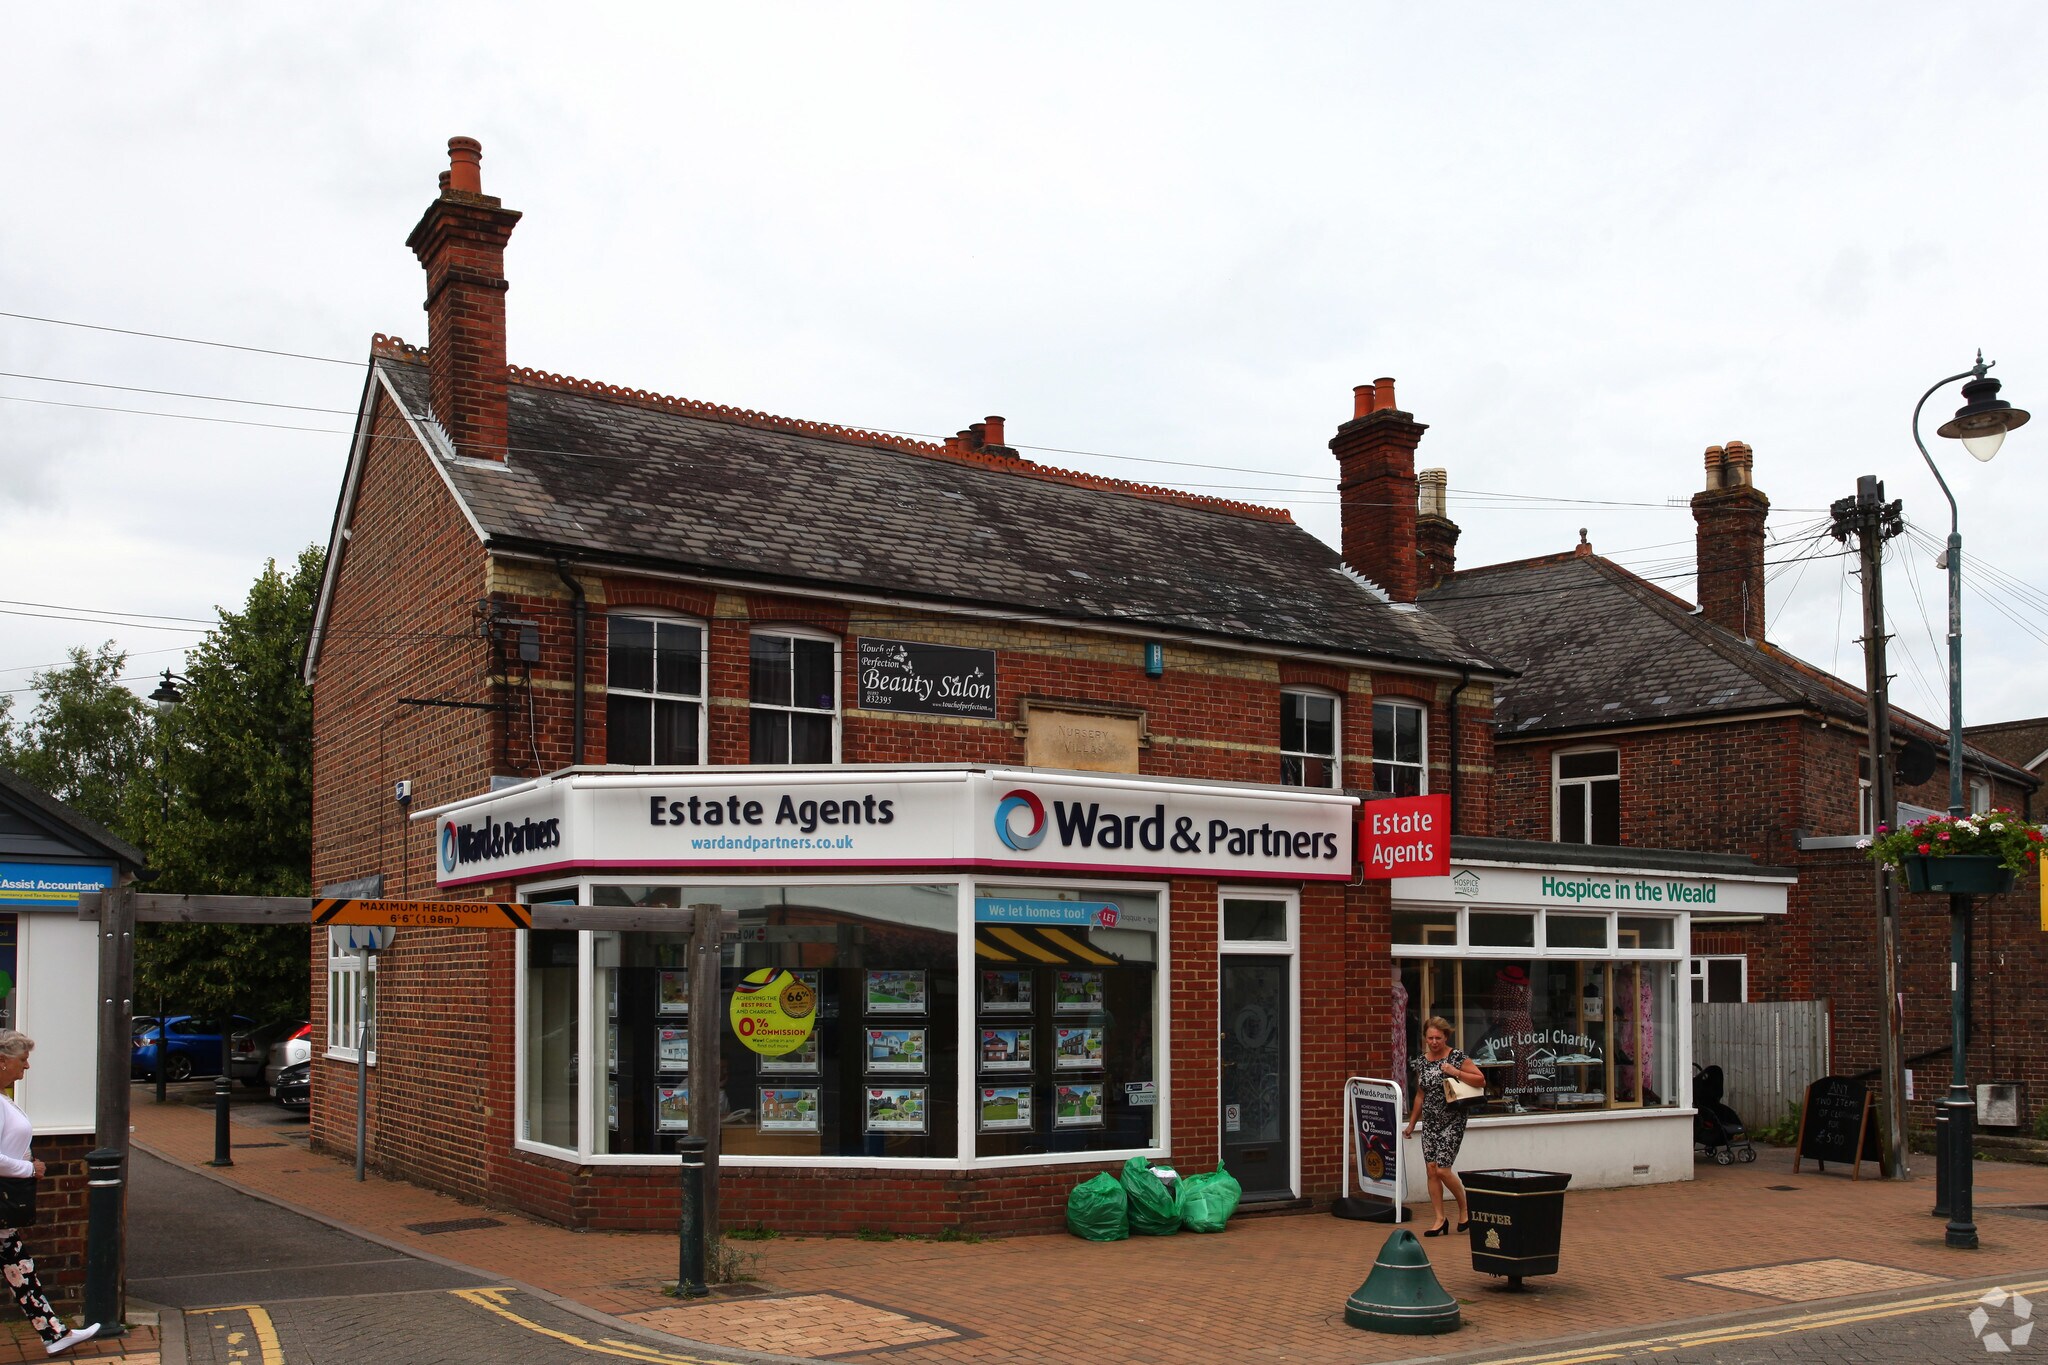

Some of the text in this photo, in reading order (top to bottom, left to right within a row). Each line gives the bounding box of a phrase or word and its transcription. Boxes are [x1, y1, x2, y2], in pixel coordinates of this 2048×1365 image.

[861, 643, 896, 658] Touch of
[861, 657, 900, 669] Perfection
[862, 668, 992, 701] Beauty Salon
[866, 696, 892, 704] 832395
[1058, 726, 1108, 739] NURSERY
[1064, 741, 1103, 754] VILLAS
[650, 794, 894, 834] Estate Agents
[1372, 810, 1432, 836] Estate
[691, 834, 854, 852] wardandpartners.co.uk
[1372, 840, 1434, 865] Agents
[37, 880, 104, 890] Accountants
[1454, 878, 1478, 886] HOSPICE
[1462, 886, 1480, 894] WEALD
[1542, 876, 1716, 904] Hospice in the Weald
[360, 902, 488, 914] MAXIMUM HEADROOM
[988, 905, 1085, 918] We let homes too!
[1102, 912, 1114, 922] LET
[788, 991, 809, 1002] 66%
[1485, 1029, 1596, 1052] Your Local Charity
[1528, 1059, 1555, 1068] HOSPICE
[1504, 1086, 1526, 1094] Rooted
[1526, 1086, 1532, 1094] in
[1546, 1084, 1578, 1093] community
[1830, 1081, 1848, 1094] ANY
[1471, 1210, 1512, 1226] LITTER
